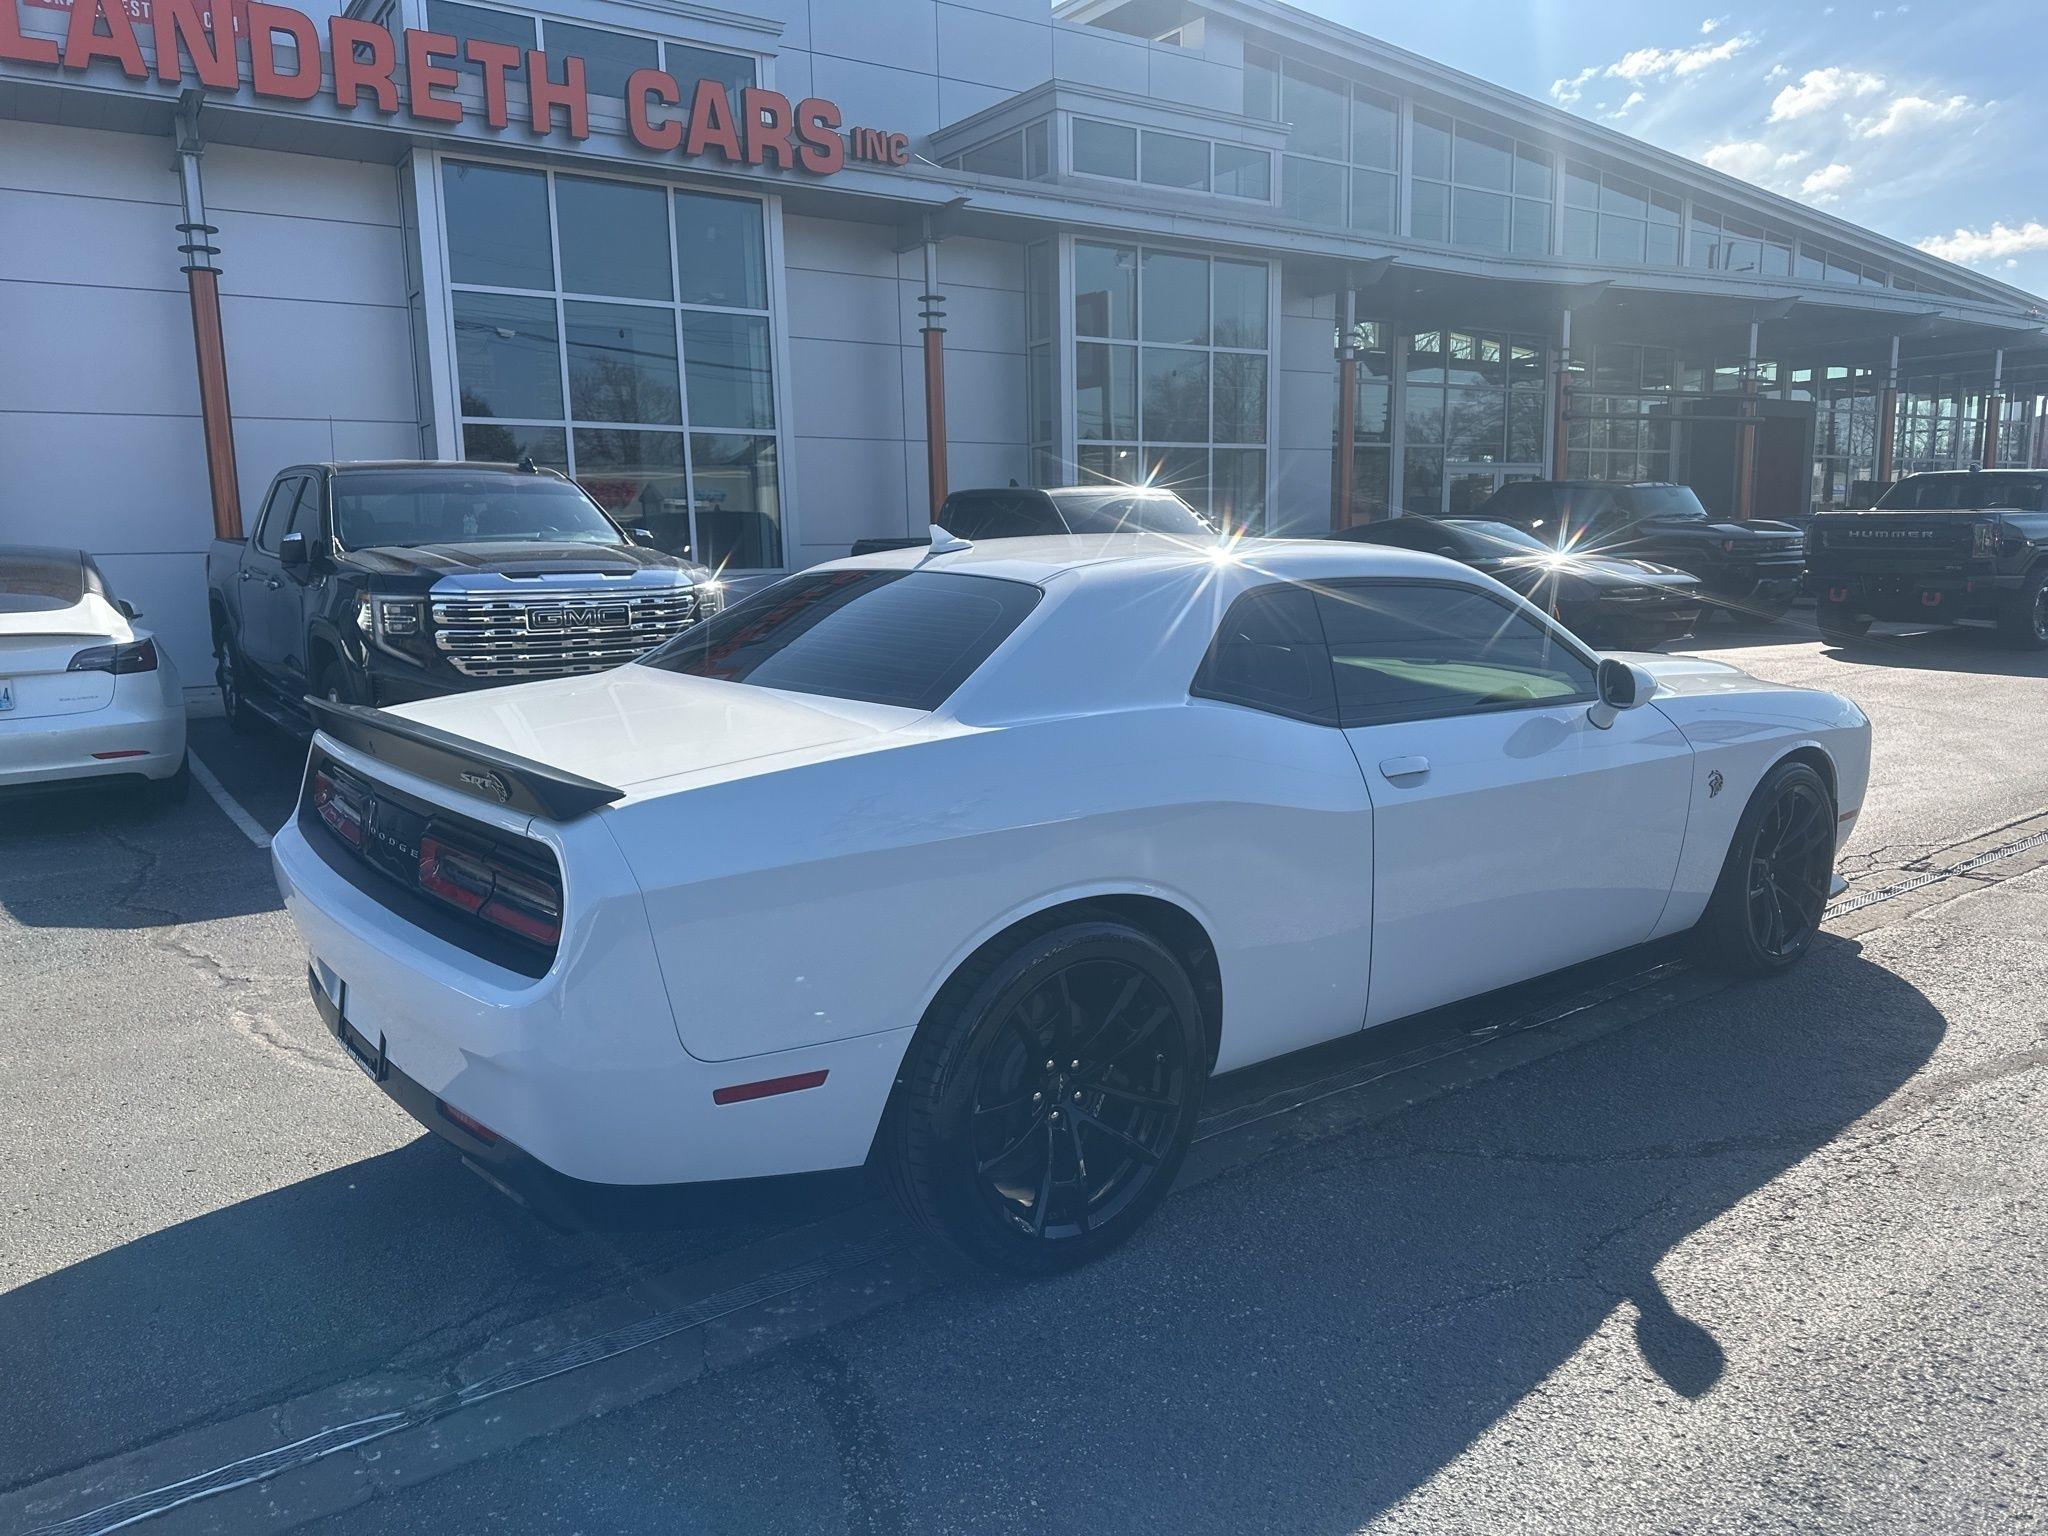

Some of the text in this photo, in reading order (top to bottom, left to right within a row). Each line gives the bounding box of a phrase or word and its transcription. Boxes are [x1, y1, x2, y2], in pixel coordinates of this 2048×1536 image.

[0, 0, 910, 175] LANDRETH CARS INC
[1848, 529, 1934, 539] HUMMER
[532, 606, 627, 628] GMC
[460, 772, 492, 790] SRT
[370, 827, 419, 859] DODGE
